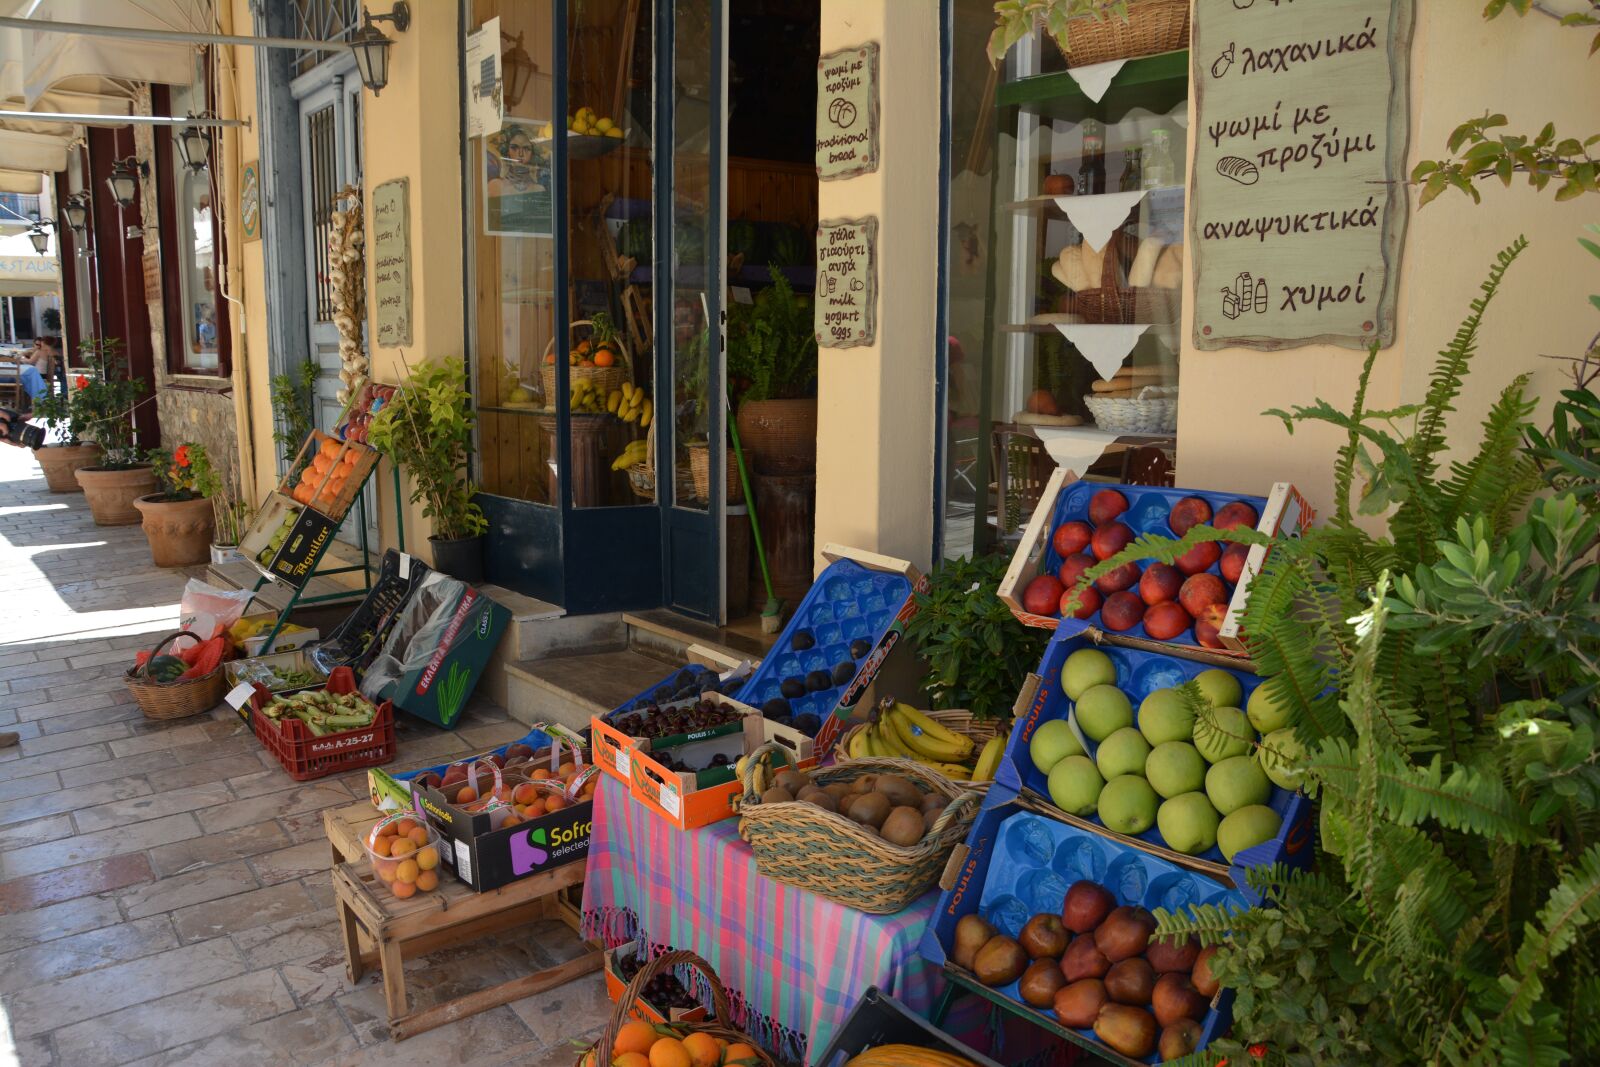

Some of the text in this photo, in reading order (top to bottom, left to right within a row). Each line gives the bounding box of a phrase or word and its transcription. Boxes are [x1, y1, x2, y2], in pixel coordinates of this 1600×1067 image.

[1241, 17, 1376, 75] λαχανικά
[825, 60, 863, 80] ψωμί με
[826, 77, 861, 94] προζύμι
[1209, 101, 1330, 147] ψωμί με
[816, 128, 868, 152] traditional
[1256, 127, 1376, 172] προζύμι
[829, 147, 857, 164] bread
[1204, 197, 1379, 242] αναψυκτικά
[829, 228, 855, 245] γάλα
[820, 242, 865, 261] γιαούρτι
[828, 259, 856, 276] αυγά
[829, 292, 856, 306] milk
[1280, 272, 1366, 311] χυμοί
[824, 310, 860, 325] yogurt
[831, 326, 852, 340] eggs
[293, 526, 328, 576] Aguilar
[1022, 689, 1049, 743] POULIS
[687, 731, 707, 740] POULIS
[947, 859, 977, 915] POULIS
